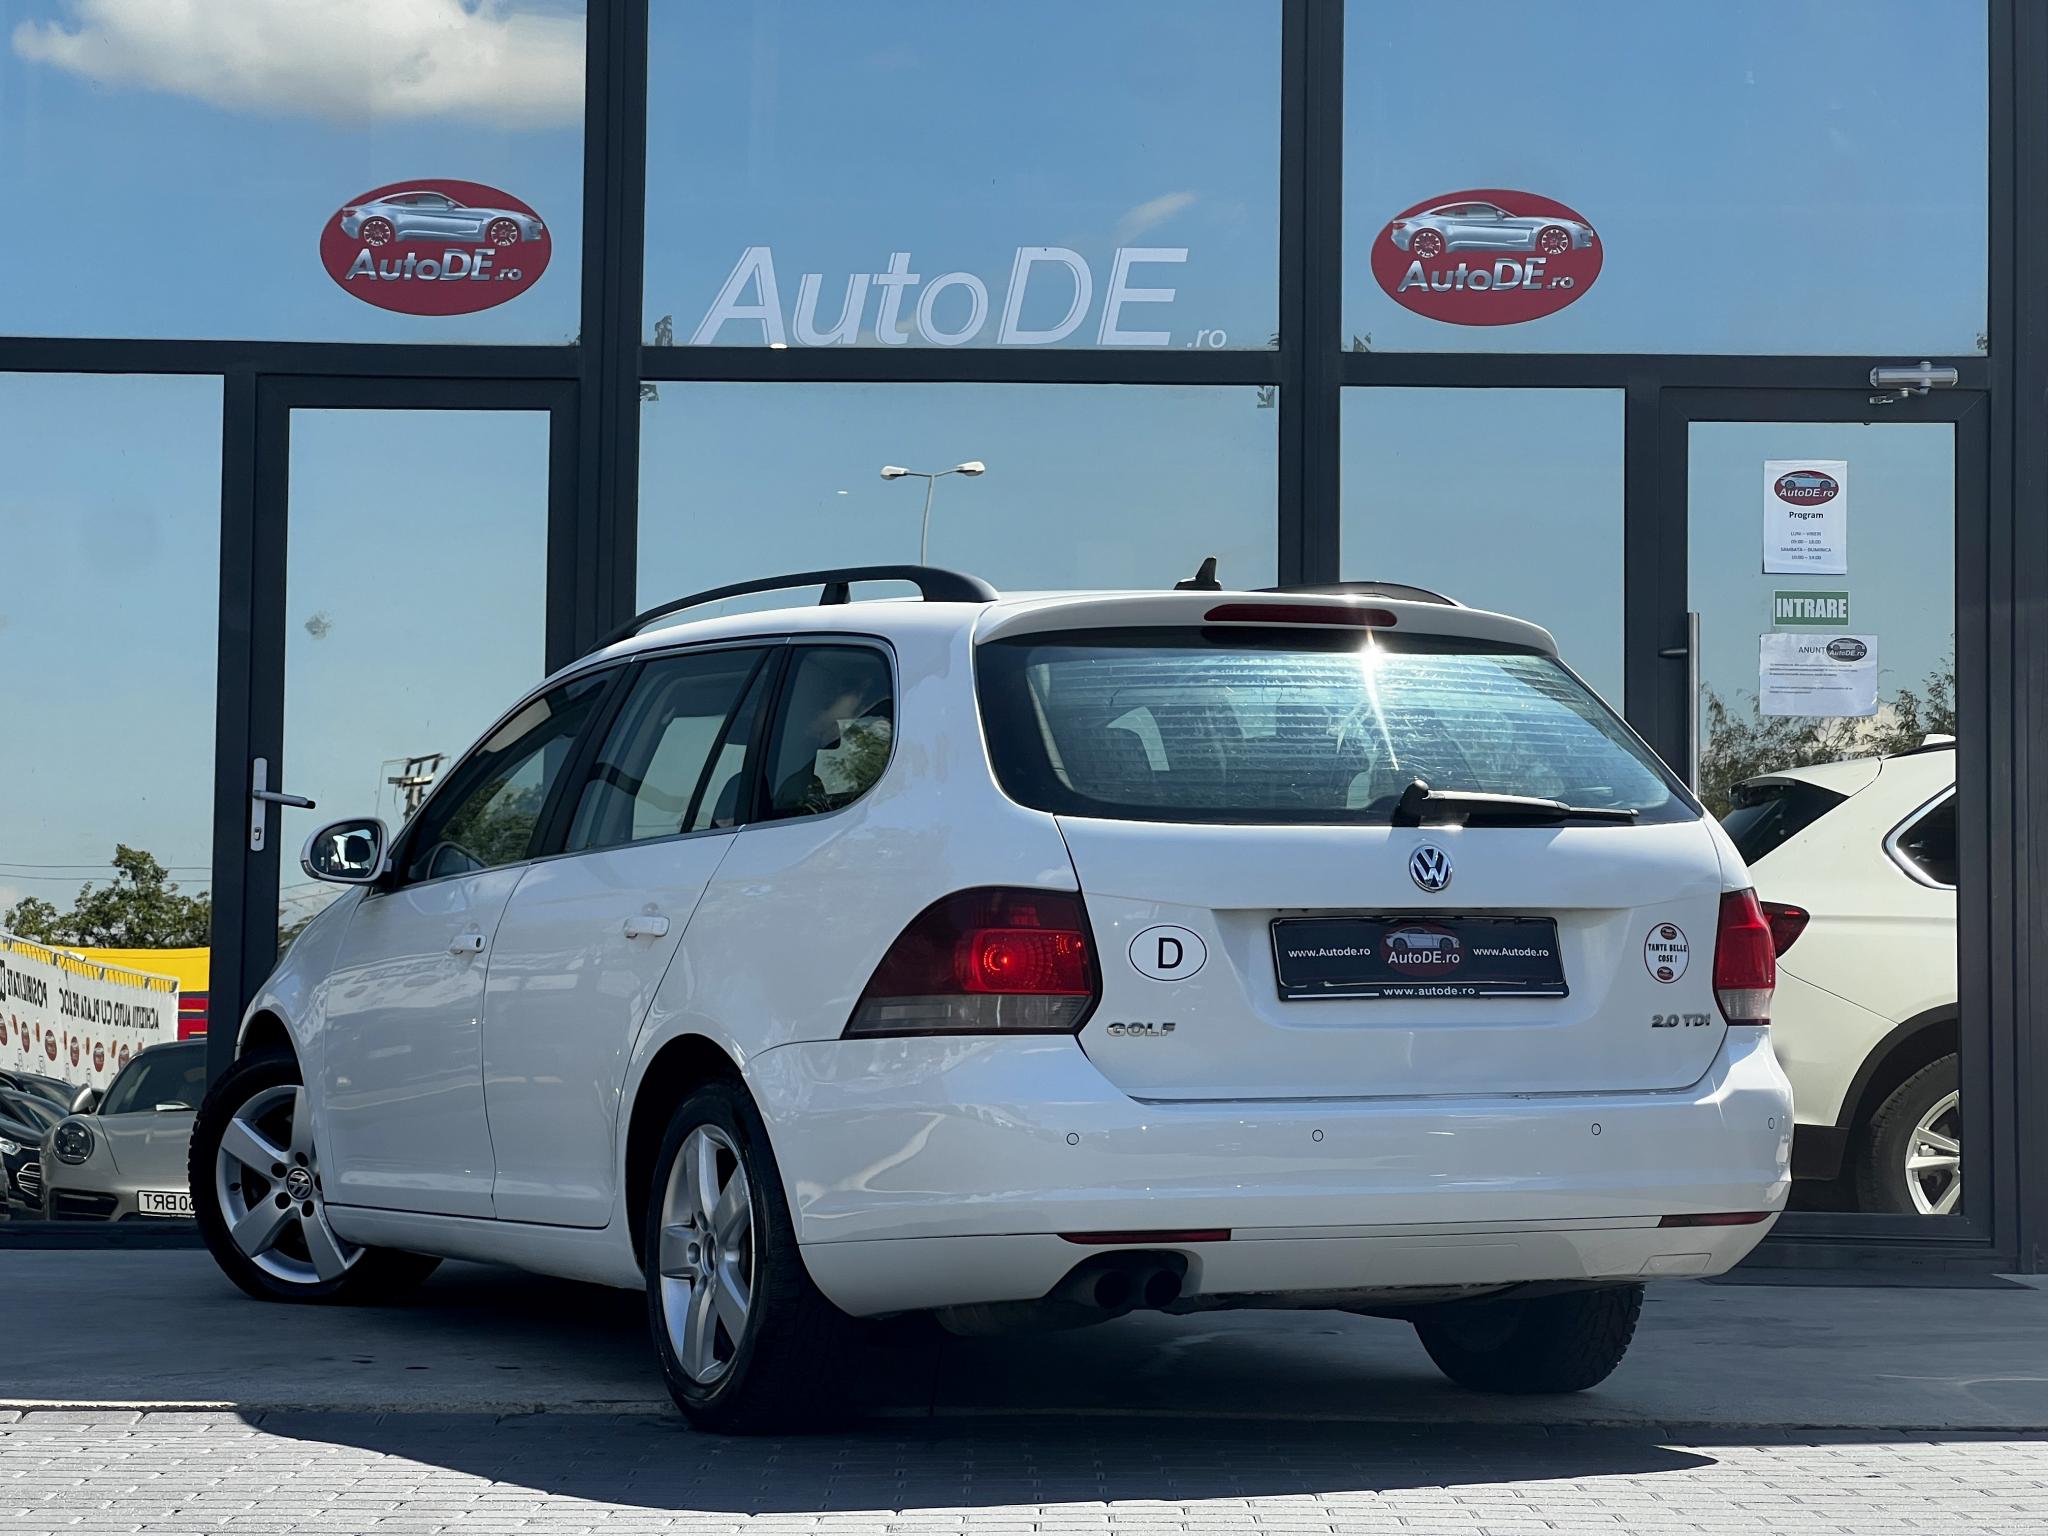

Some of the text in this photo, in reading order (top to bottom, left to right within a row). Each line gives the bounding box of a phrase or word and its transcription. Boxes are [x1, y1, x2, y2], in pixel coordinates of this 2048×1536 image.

[1779, 487, 1835, 498] AutoDE.ro
[1788, 511, 1824, 520] Program
[1776, 598, 1847, 618] INTRARE
[1157, 937, 1184, 969] D
[1288, 947, 1371, 958] www.Autode.ro
[1473, 946, 1549, 958] www.Autode.ro
[1648, 943, 1667, 952] TANTE
[1387, 950, 1461, 965] AutoDE.ro
[1658, 955, 1673, 963] COSE
[1383, 986, 1476, 997] www.autode.ro
[1682, 1013, 1711, 1027] TDI
[1107, 1022, 1176, 1037] GOLF
